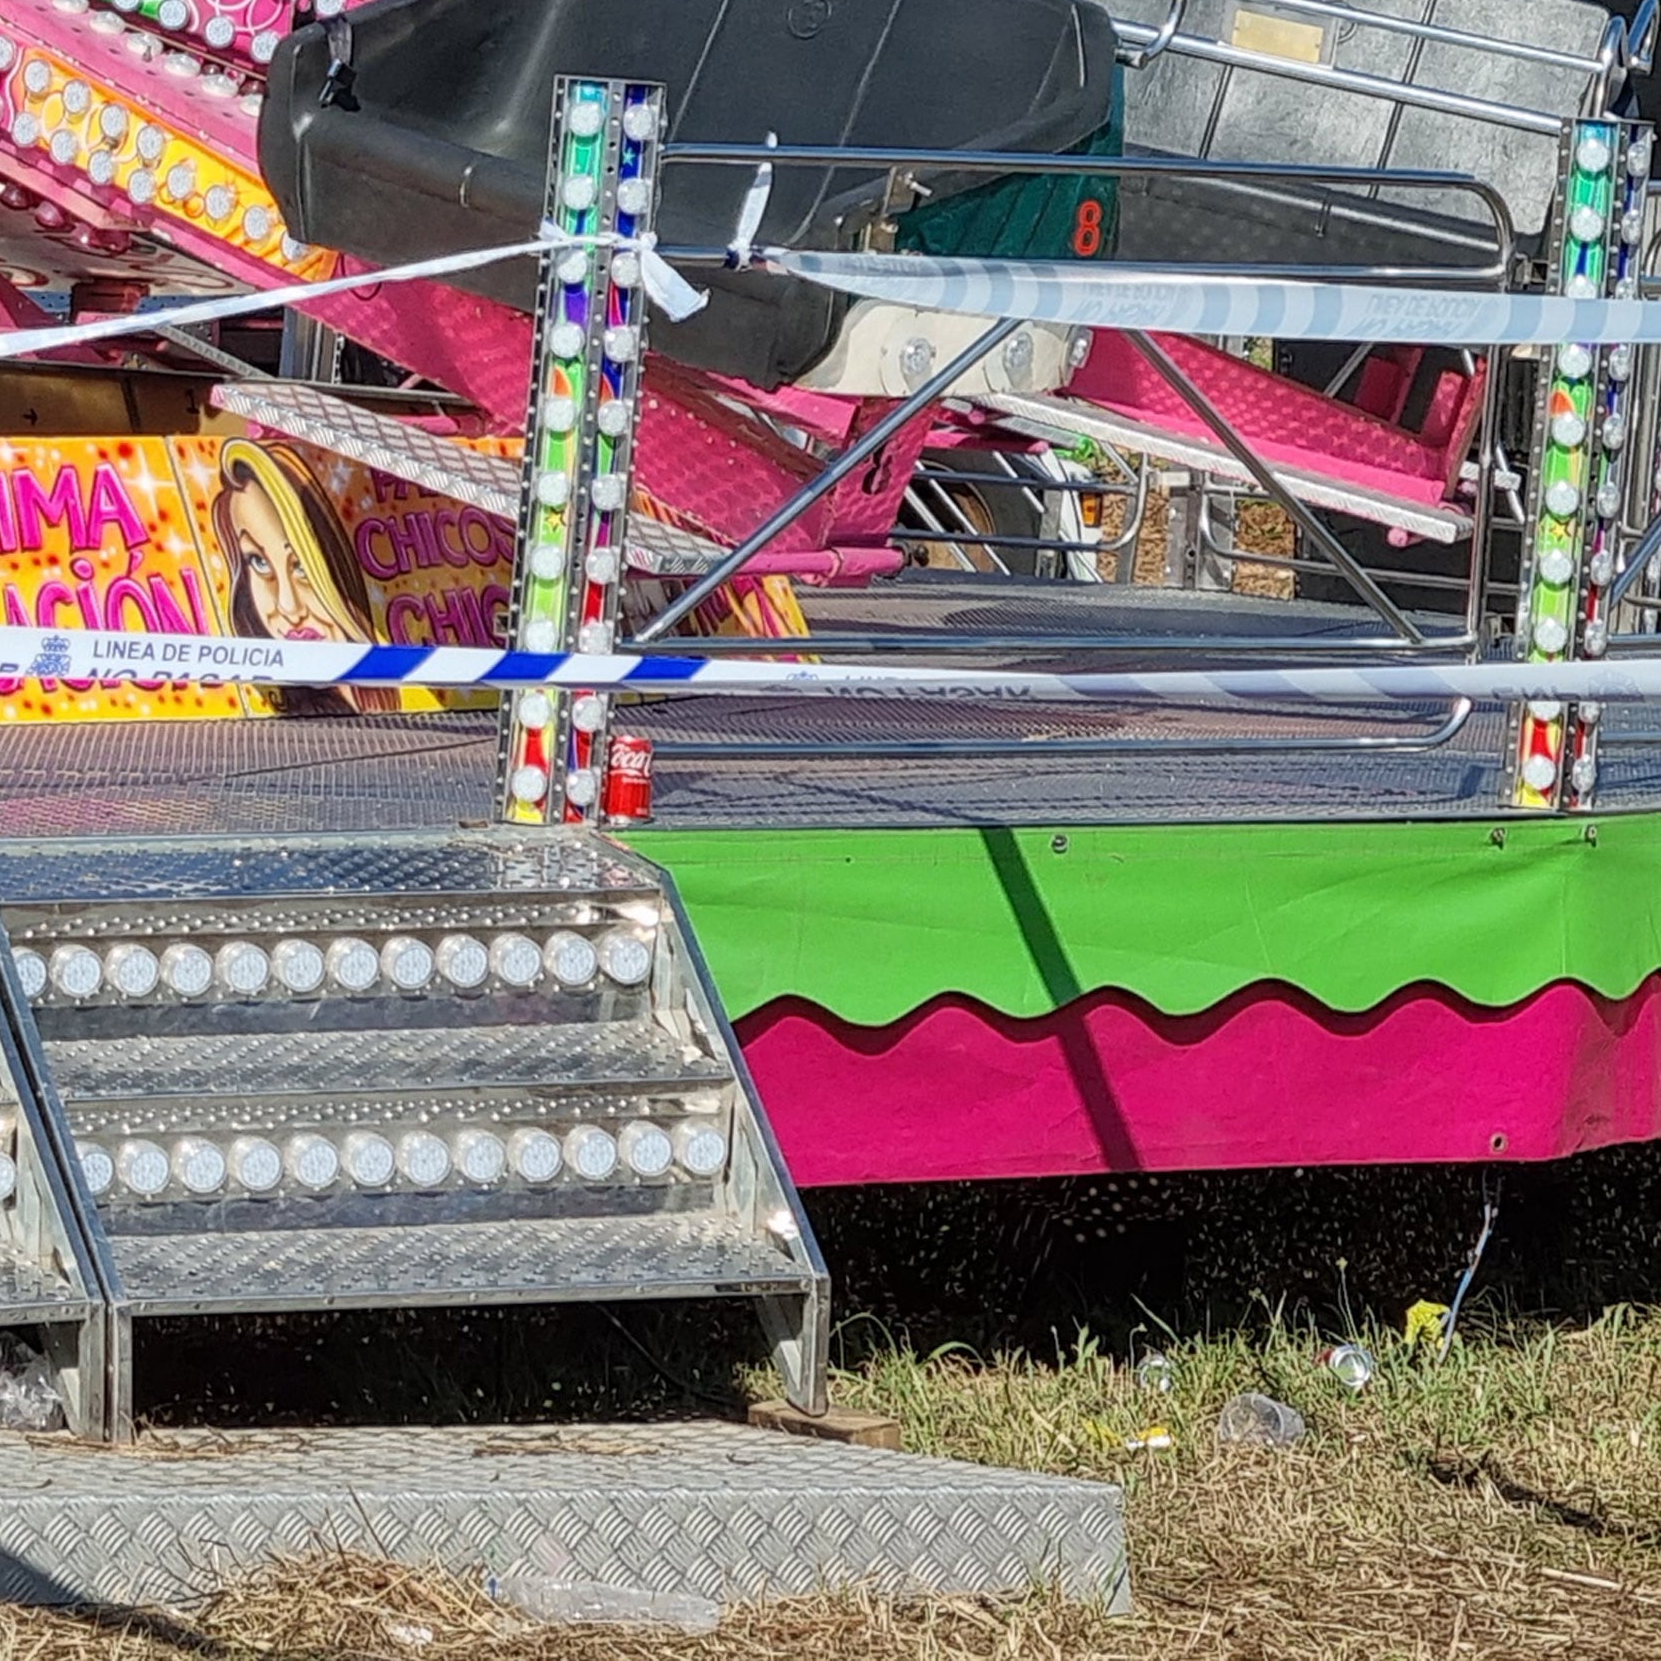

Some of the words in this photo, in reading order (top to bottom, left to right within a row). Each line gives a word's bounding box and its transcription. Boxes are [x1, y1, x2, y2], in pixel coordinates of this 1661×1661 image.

[1073, 198, 1102, 257] 8
[92, 639, 156, 661] LINEA
[162, 643, 192, 663] DE
[197, 645, 285, 667] POLICIA
